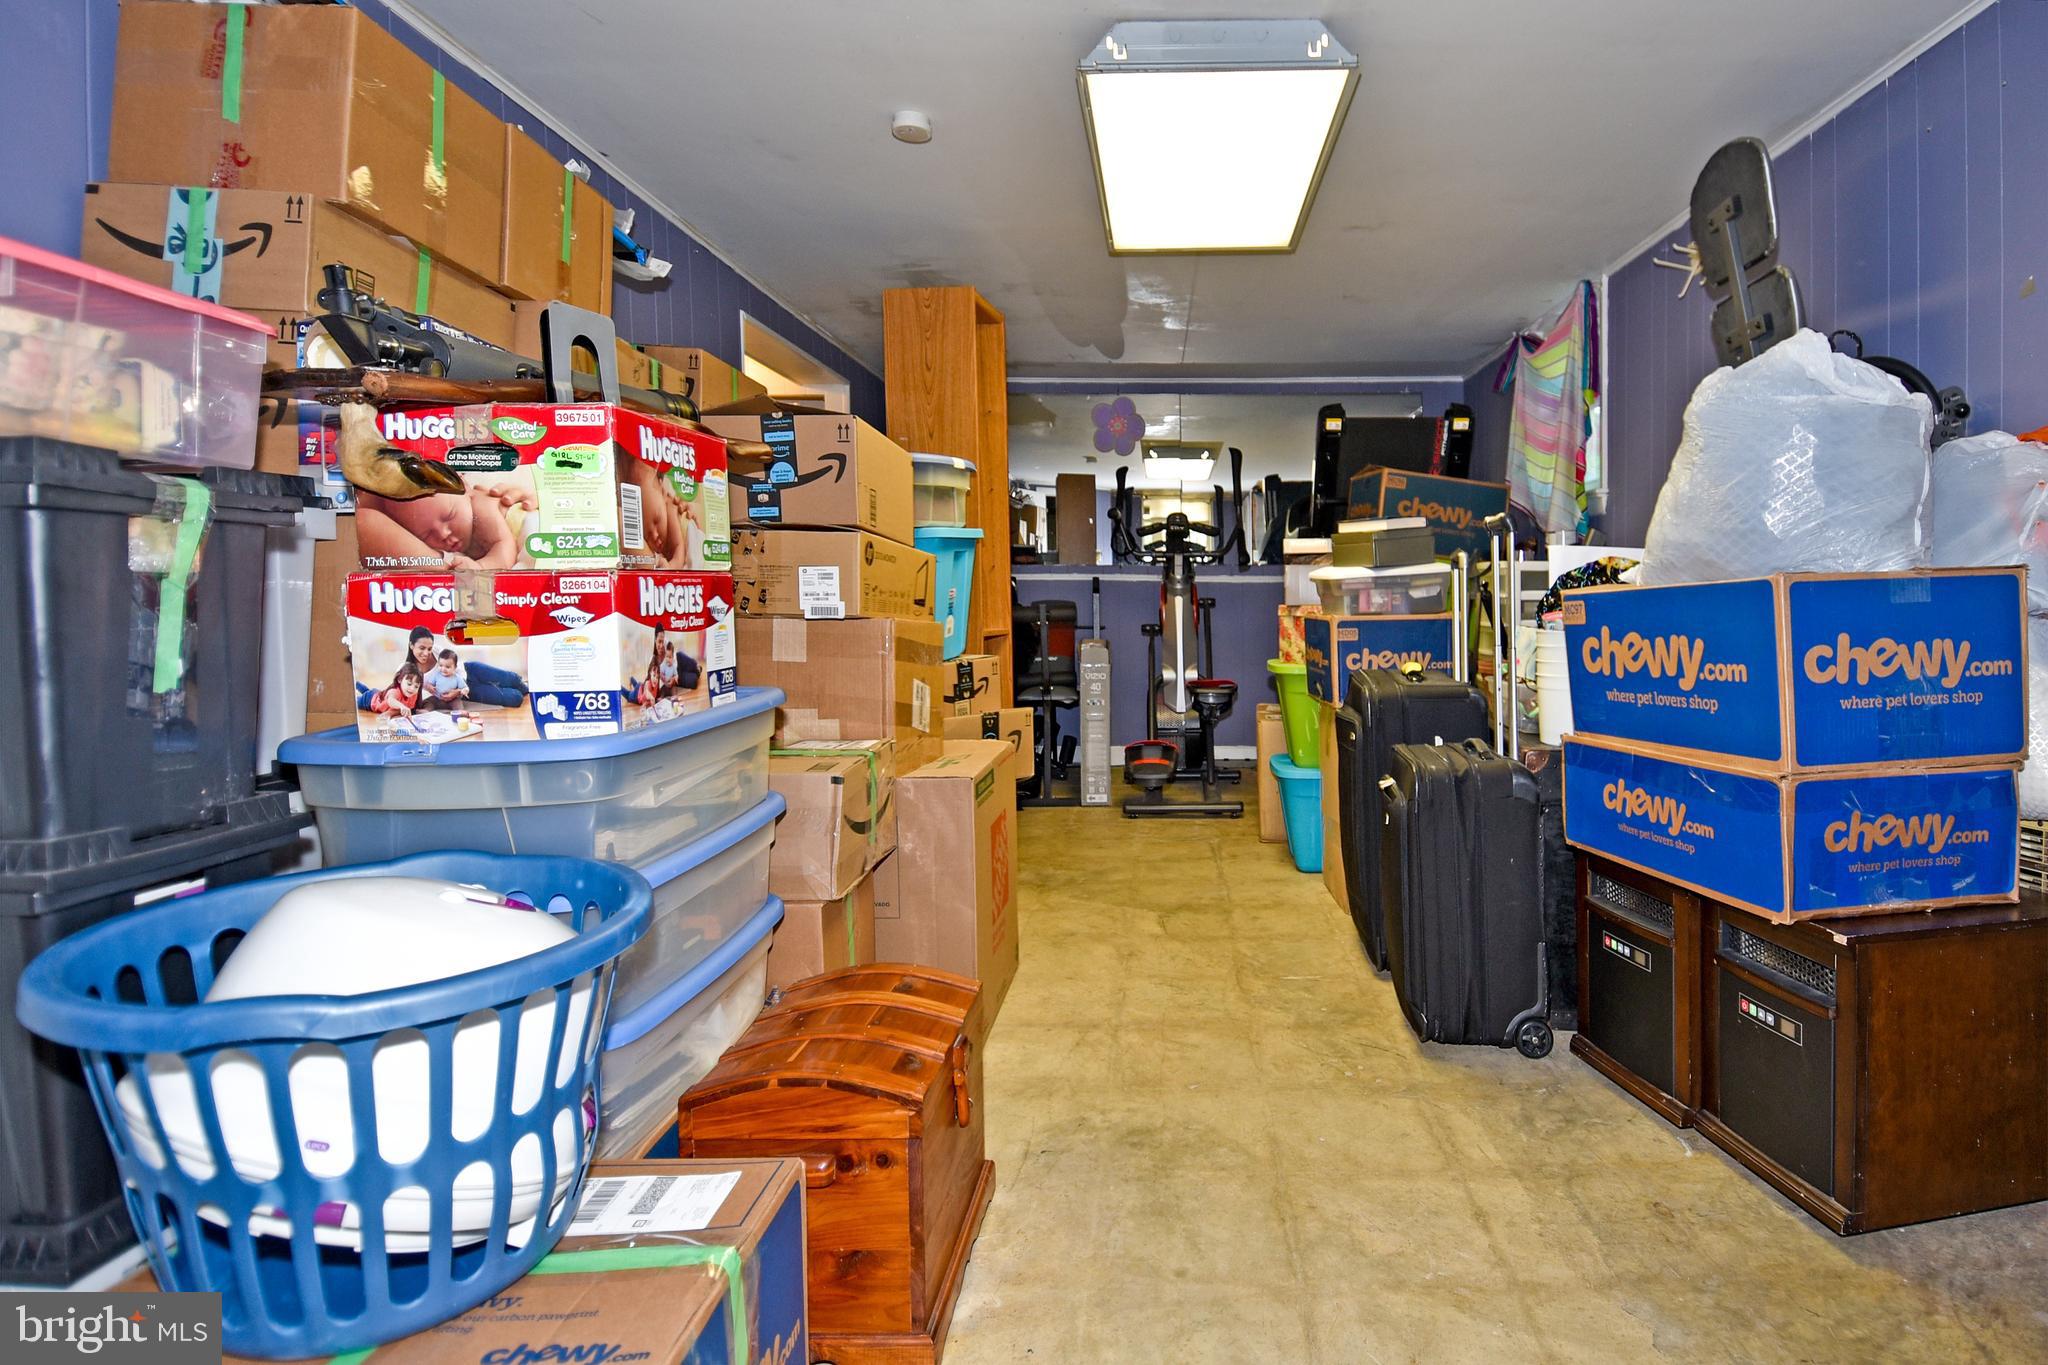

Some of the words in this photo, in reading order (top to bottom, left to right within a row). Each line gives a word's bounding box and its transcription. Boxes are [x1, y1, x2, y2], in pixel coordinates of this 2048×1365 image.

[384, 411, 490, 440] HUGGIES
[498, 420, 537, 431] Natural
[511, 429, 536, 439] Care
[639, 424, 697, 471] HUGGIES
[551, 451, 572, 460] GIRL
[479, 460, 502, 468] Cooper
[673, 471, 695, 486] Natural
[681, 483, 694, 494] Care
[556, 535, 583, 549] 624
[369, 581, 478, 613] HUGGIE
[495, 592, 538, 607] Simply
[540, 592, 579, 605] Clean
[639, 576, 704, 616] HUGGIES
[710, 605, 728, 616] Wipes
[556, 614, 587, 623] Wipes
[670, 616, 689, 629] Simply
[688, 616, 704, 627] Clean
[1582, 625, 1748, 691] chewy.com
[1803, 632, 2013, 688] chewy.com
[721, 669, 734, 684] 768
[1090, 682, 1101, 692] 40
[573, 693, 610, 711] 768
[1606, 688, 1635, 704] where
[1637, 692, 1652, 707] pet
[1655, 691, 1687, 707] lovers
[1689, 695, 1718, 714] shop
[1840, 696, 1882, 709] where
[1885, 695, 1907, 709] pet
[1909, 692, 1949, 705] lovers
[1952, 690, 1983, 704] shop
[1603, 778, 1715, 839] chewy.com
[1618, 823, 1638, 836] where
[1639, 830, 1650, 840] pet
[1652, 831, 1674, 847] lovers
[1675, 839, 1696, 855] shop
[1824, 809, 1989, 854] chewy.com
[1848, 861, 1880, 873] where
[1883, 859, 1900, 872] pet
[1902, 857, 1933, 868] lovers
[1936, 854, 1961, 867] shop
[493, 1312, 536, 1322] carbon
